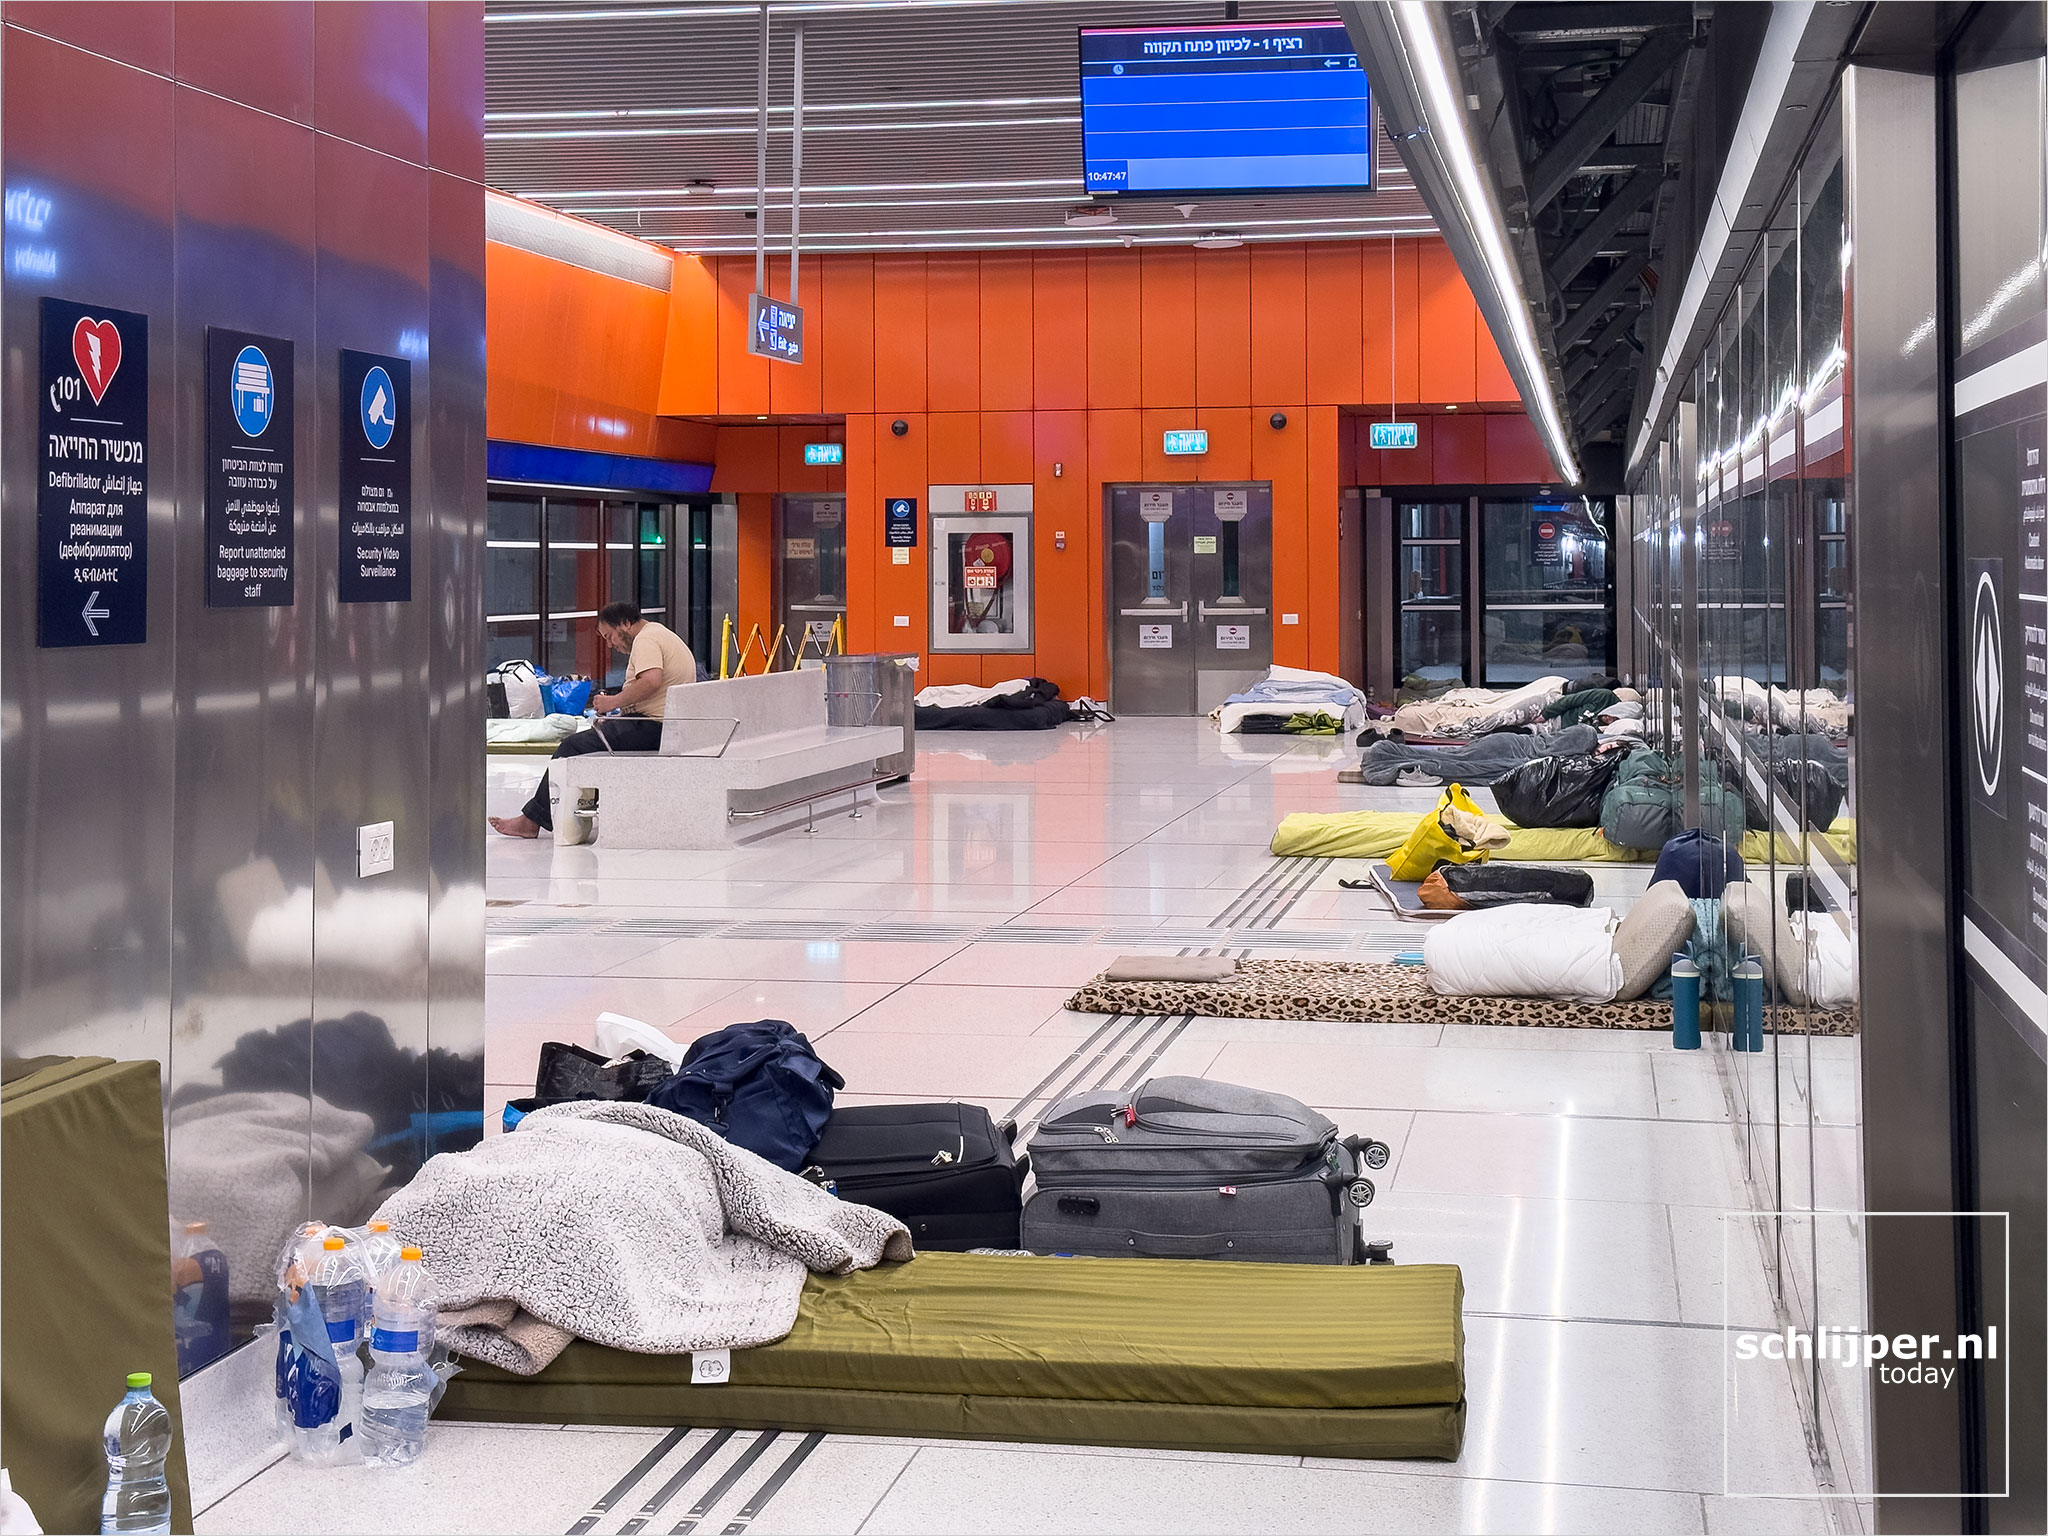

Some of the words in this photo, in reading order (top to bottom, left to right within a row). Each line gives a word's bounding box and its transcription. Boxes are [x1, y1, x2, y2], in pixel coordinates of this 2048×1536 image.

[1143, 41, 1182, 56] תקווה
[1184, 40, 1213, 52] פתח
[1215, 37, 1251, 54] לכיוון
[1262, 38, 1269, 50] 1
[1272, 37, 1303, 52] רציף
[1088, 171, 1127, 181] 10:47:47
[57, 375, 80, 401] 101
[1179, 433, 1204, 451] יציאה
[1387, 426, 1414, 446] יציאה
[49, 434, 98, 460] החייאה
[101, 439, 143, 463] מכשיר
[49, 471, 101, 489] Defibrillator
[102, 474, 126, 494] إنعاش
[126, 475, 143, 495] جهاز
[228, 476, 247, 488] עזובה
[248, 477, 267, 489] כבודה
[268, 476, 278, 490] על
[69, 498, 106, 518] Аппарат
[107, 503, 123, 518] для
[70, 523, 123, 539] реанимации
[267, 520, 277, 536] عن
[59, 541, 133, 560] (дефибриллятор)
[219, 544, 244, 561] Report
[245, 546, 286, 559] unattended
[356, 546, 382, 562] Security
[382, 547, 400, 560] Video
[217, 565, 249, 581] baggage
[250, 565, 258, 578] to
[259, 565, 288, 581] security
[360, 564, 397, 577] Surveillance
[244, 583, 262, 597] staff
